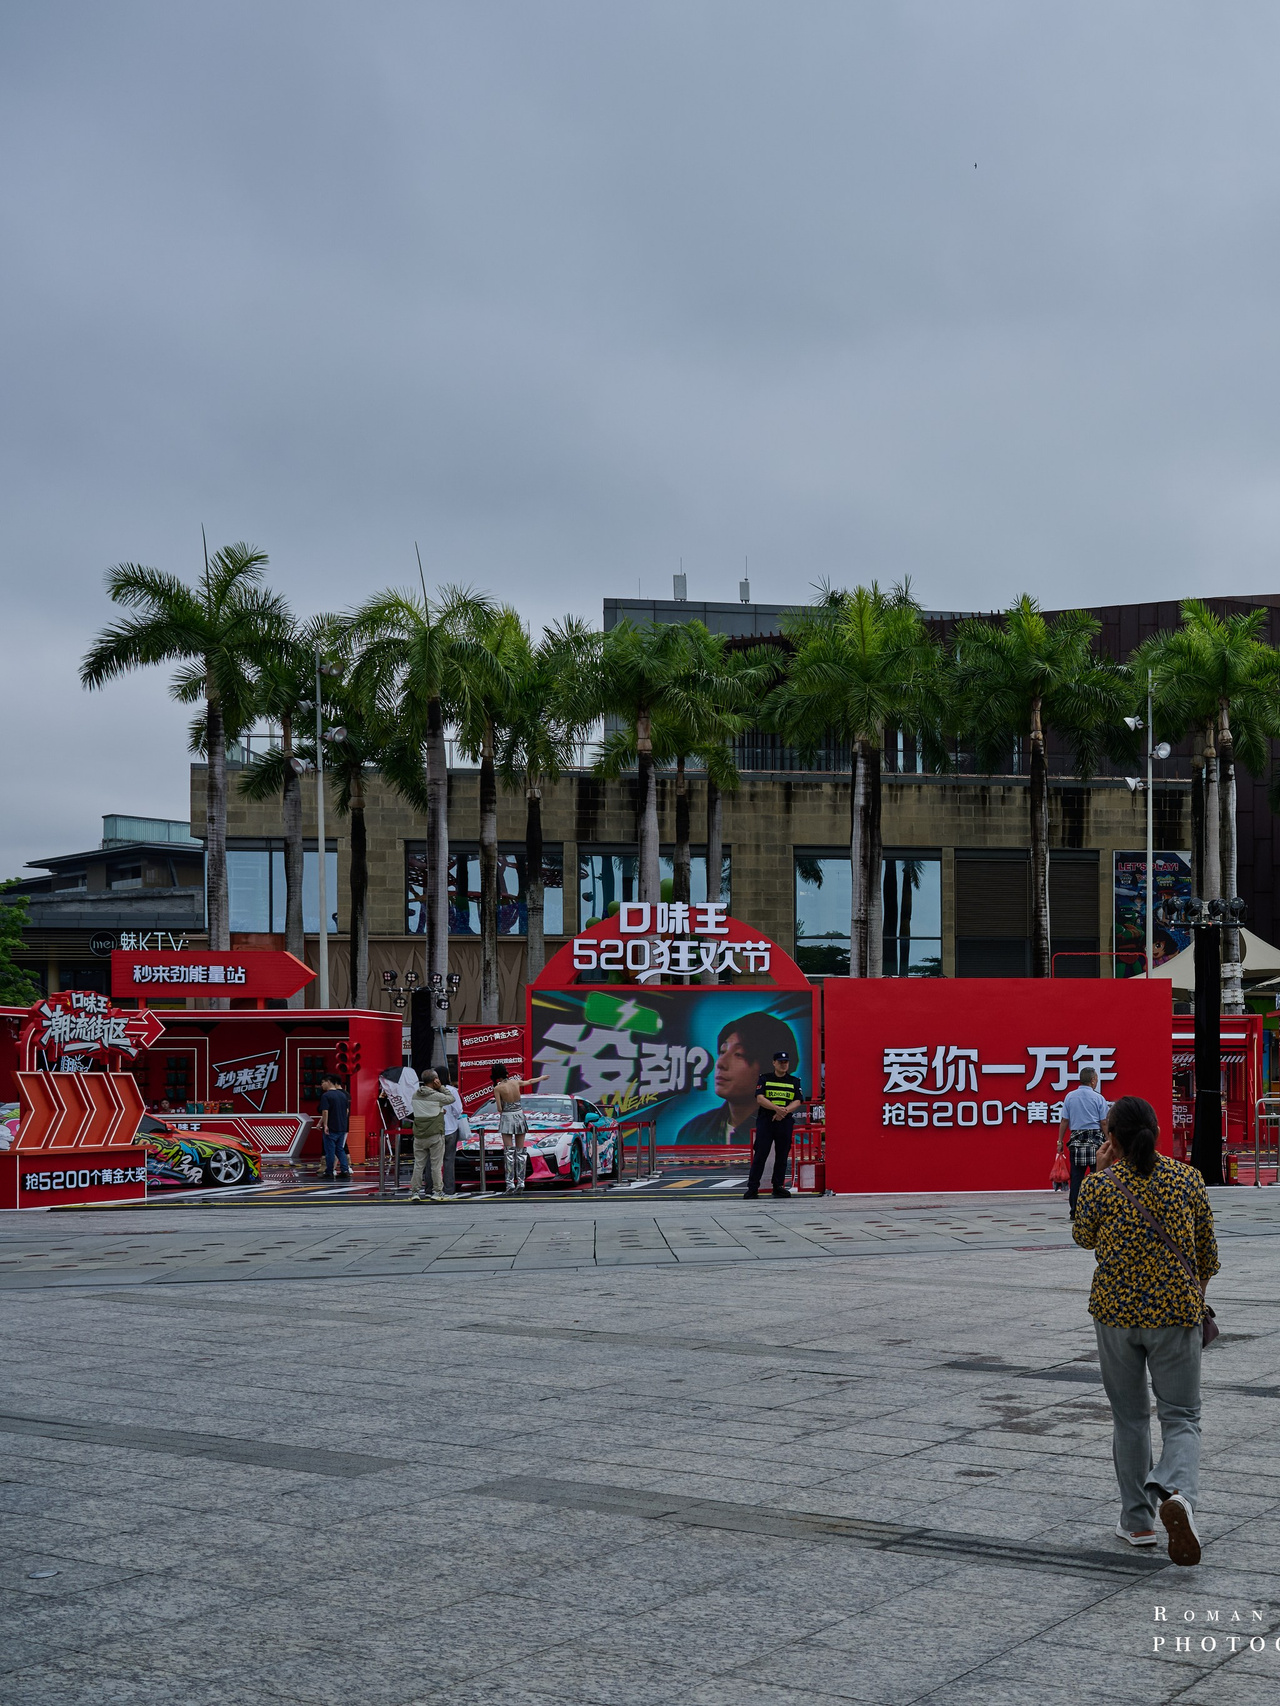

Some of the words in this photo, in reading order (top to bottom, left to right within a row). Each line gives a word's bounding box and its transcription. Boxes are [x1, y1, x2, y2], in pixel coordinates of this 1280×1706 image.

[1118, 862, 1147, 872] LET'S
[619, 901, 730, 935] 口味王
[133, 965, 246, 984] 秒来劲能量站
[573, 938, 772, 984] 520狂欢节
[71, 992, 109, 1014] 口味王
[40, 1003, 133, 1048] 潮流街区
[214, 1061, 279, 1090] 秒来劲
[882, 1045, 1118, 1095] 爱你一万年
[882, 1100, 1117, 1128] 抢5200个黄金
[25, 1166, 147, 1191] 抢5200个黄金大奖
